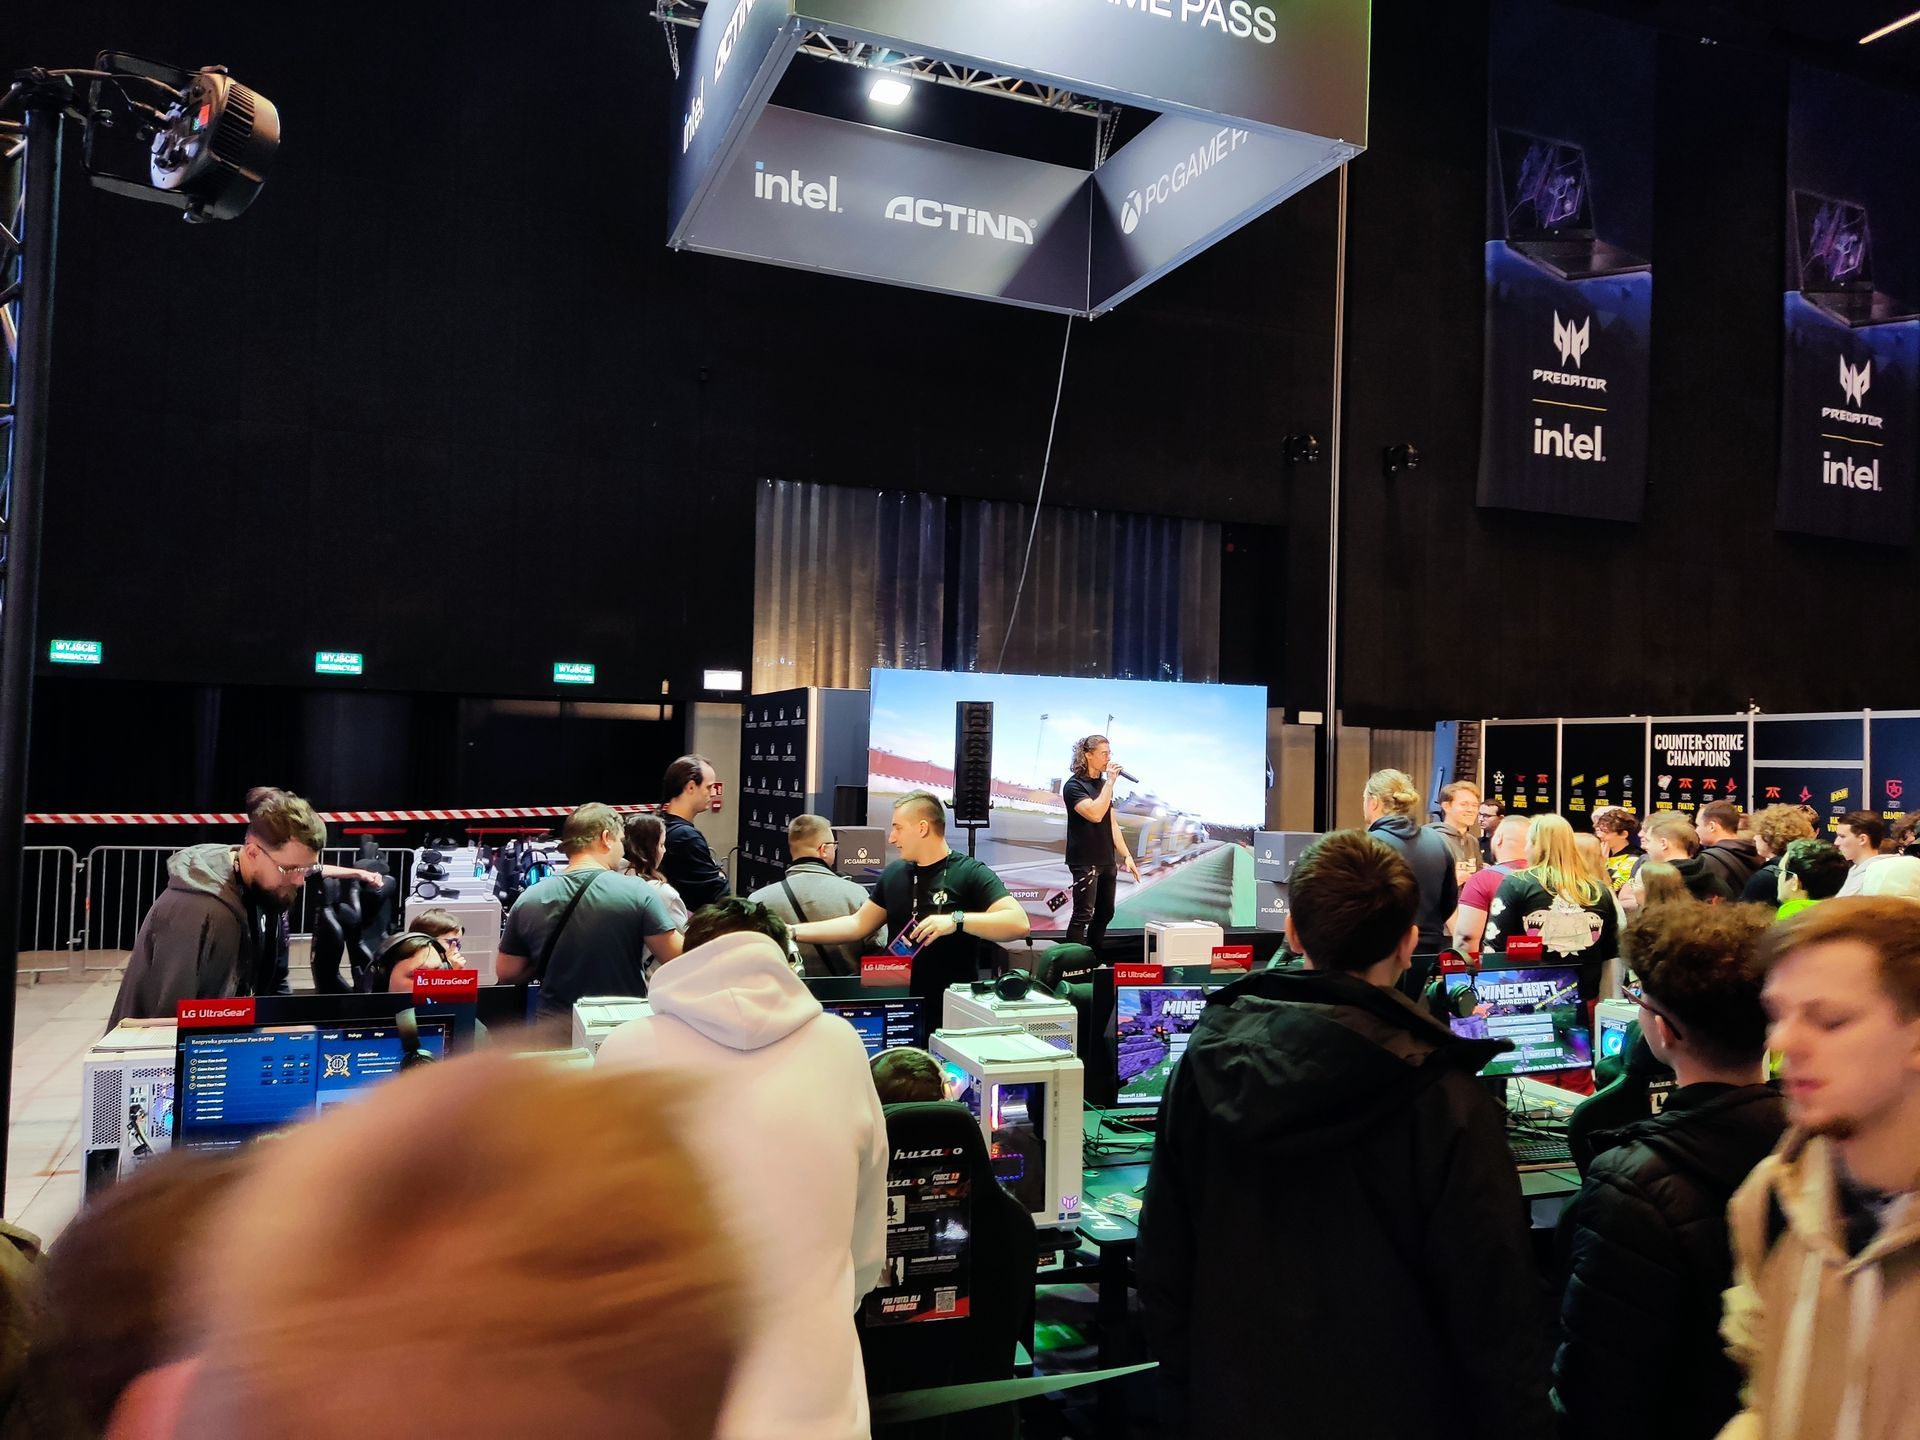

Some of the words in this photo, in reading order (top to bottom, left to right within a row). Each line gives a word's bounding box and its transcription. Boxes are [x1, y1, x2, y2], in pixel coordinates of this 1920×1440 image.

[1145, 174, 1169, 214] PC
[1171, 127, 1228, 192] GAME
[754, 160, 838, 213] intel
[1532, 368, 1607, 393] PREDATOR
[1822, 406, 1883, 430] PREDATOR
[1533, 417, 1602, 462] intel
[1823, 450, 1880, 492] intel
[1654, 734, 1745, 751] COUNTER-STRIKE
[1666, 750, 1731, 768] CHAMPIONS
[417, 976, 429, 986] LG
[431, 977, 474, 986] UltraGear
[1062, 968, 1091, 977] huzao
[1128, 971, 1159, 979] UltraGear
[1479, 981, 1557, 1001] MINECRAFT
[182, 1009, 196, 1019] LG
[199, 1007, 251, 1018] UltraGear
[894, 1147, 963, 1160] huzao
